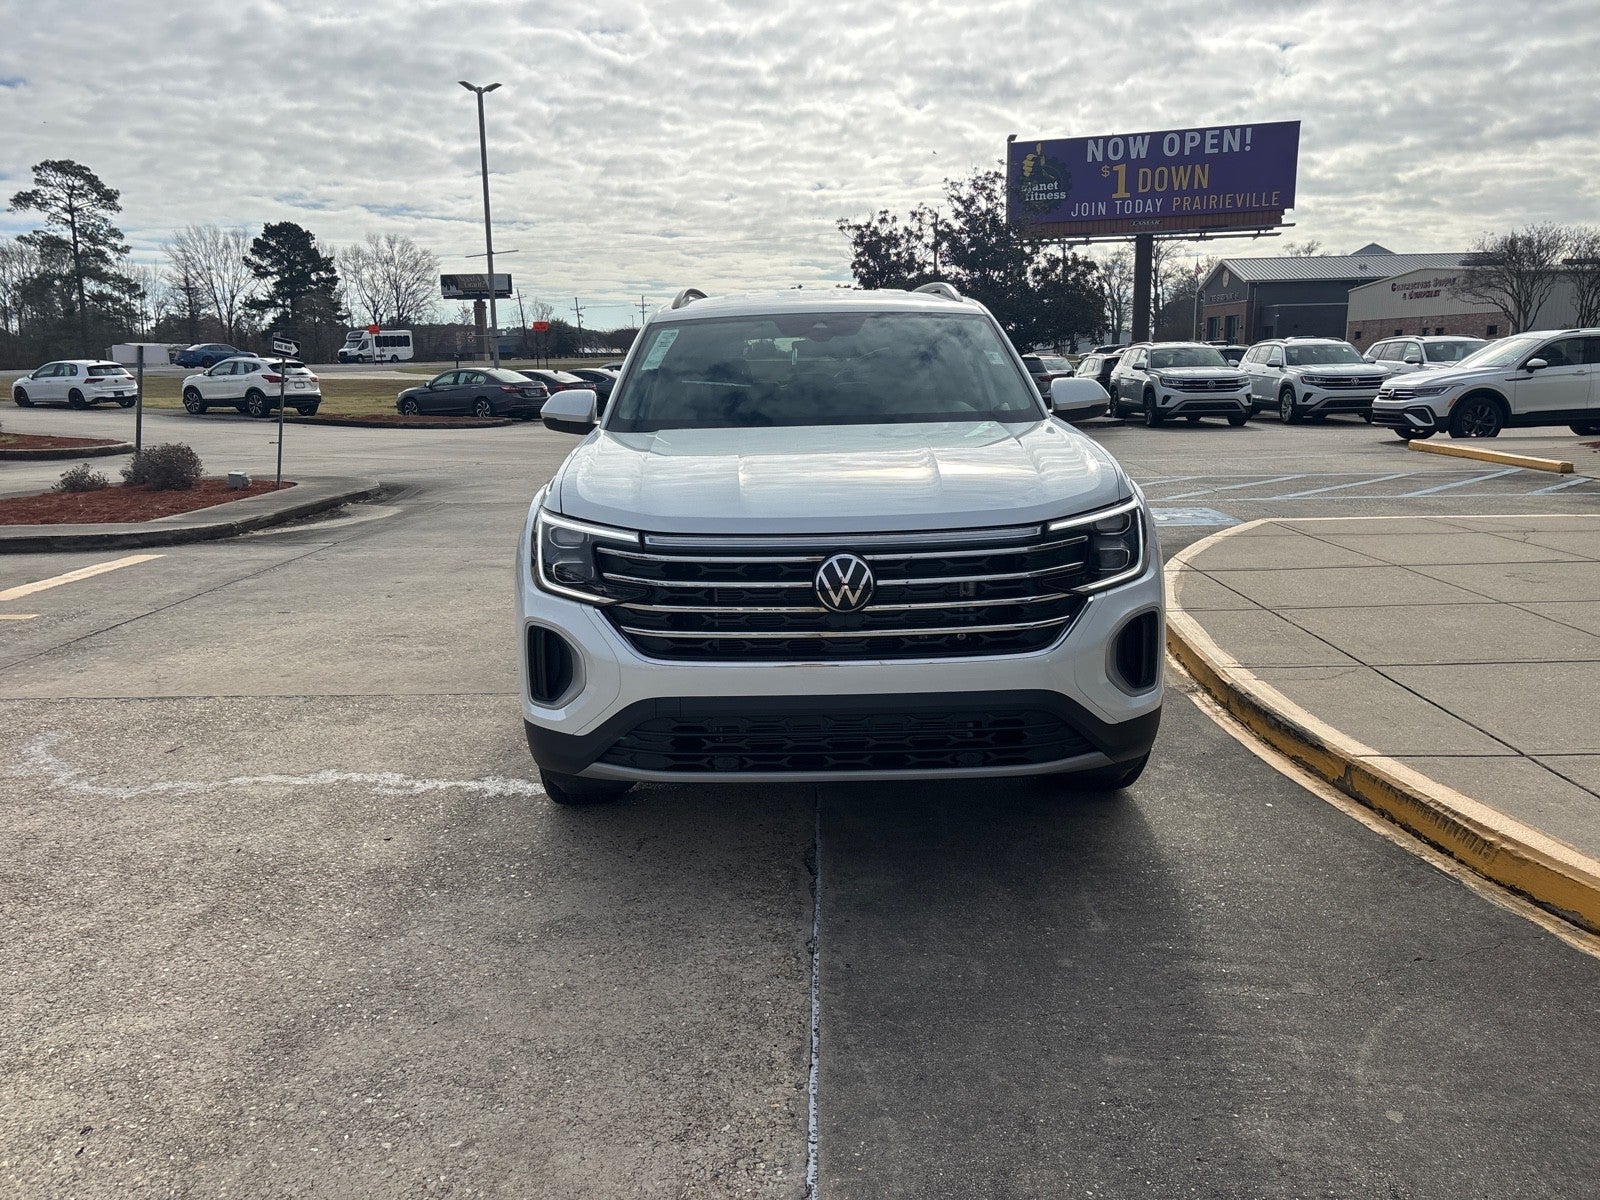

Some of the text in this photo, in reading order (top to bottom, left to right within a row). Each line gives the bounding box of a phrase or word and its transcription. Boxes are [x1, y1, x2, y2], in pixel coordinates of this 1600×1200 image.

[1086, 127, 1253, 163] NOW OPEN!
[1137, 164, 1210, 193] DOWN
[1070, 191, 1281, 217] JOIN TODAY PRAIRIEVILLE
[816, 554, 874, 612] VW
